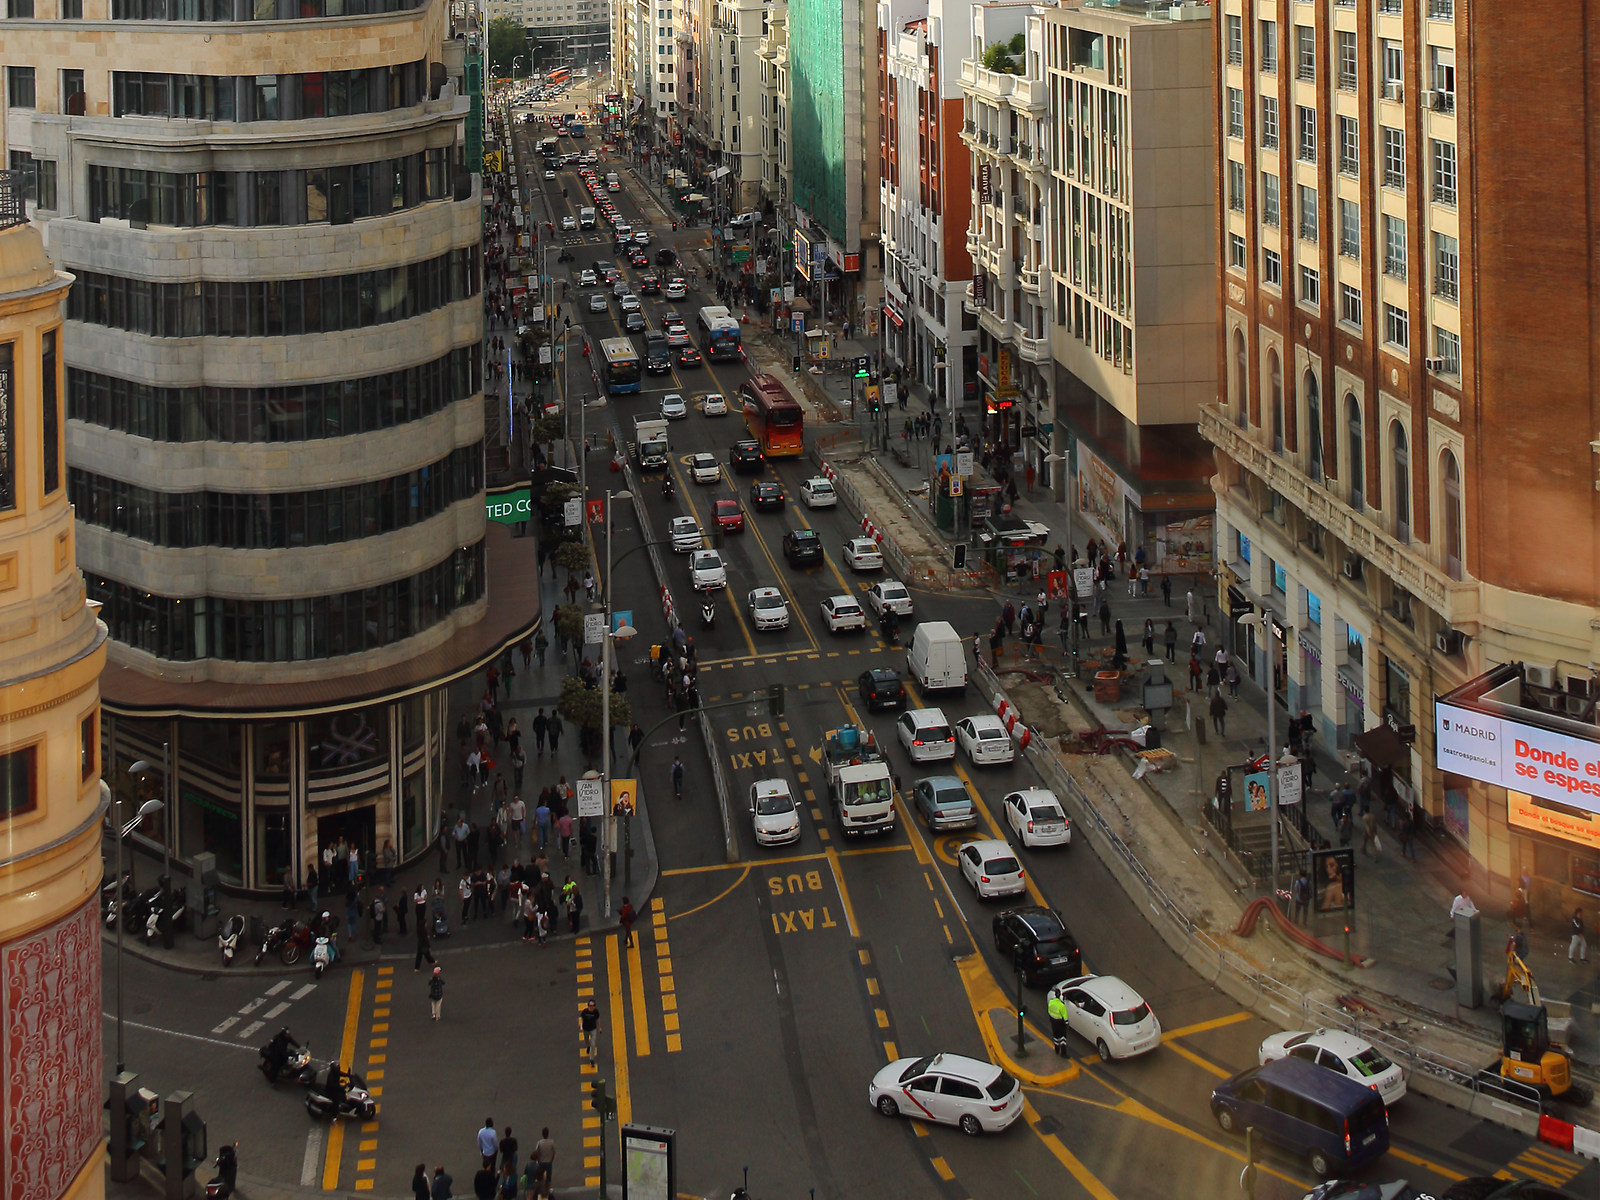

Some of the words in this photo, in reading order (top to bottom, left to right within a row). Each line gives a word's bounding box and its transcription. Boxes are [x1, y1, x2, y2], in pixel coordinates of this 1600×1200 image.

[727, 723, 772, 742] BUS
[1455, 723, 1496, 741] MADRID
[731, 749, 785, 770] TAXI
[1515, 739, 1579, 772] Donde
[1515, 762, 1538, 779] se
[768, 870, 822, 895] BUS
[772, 906, 836, 934] TAXI
